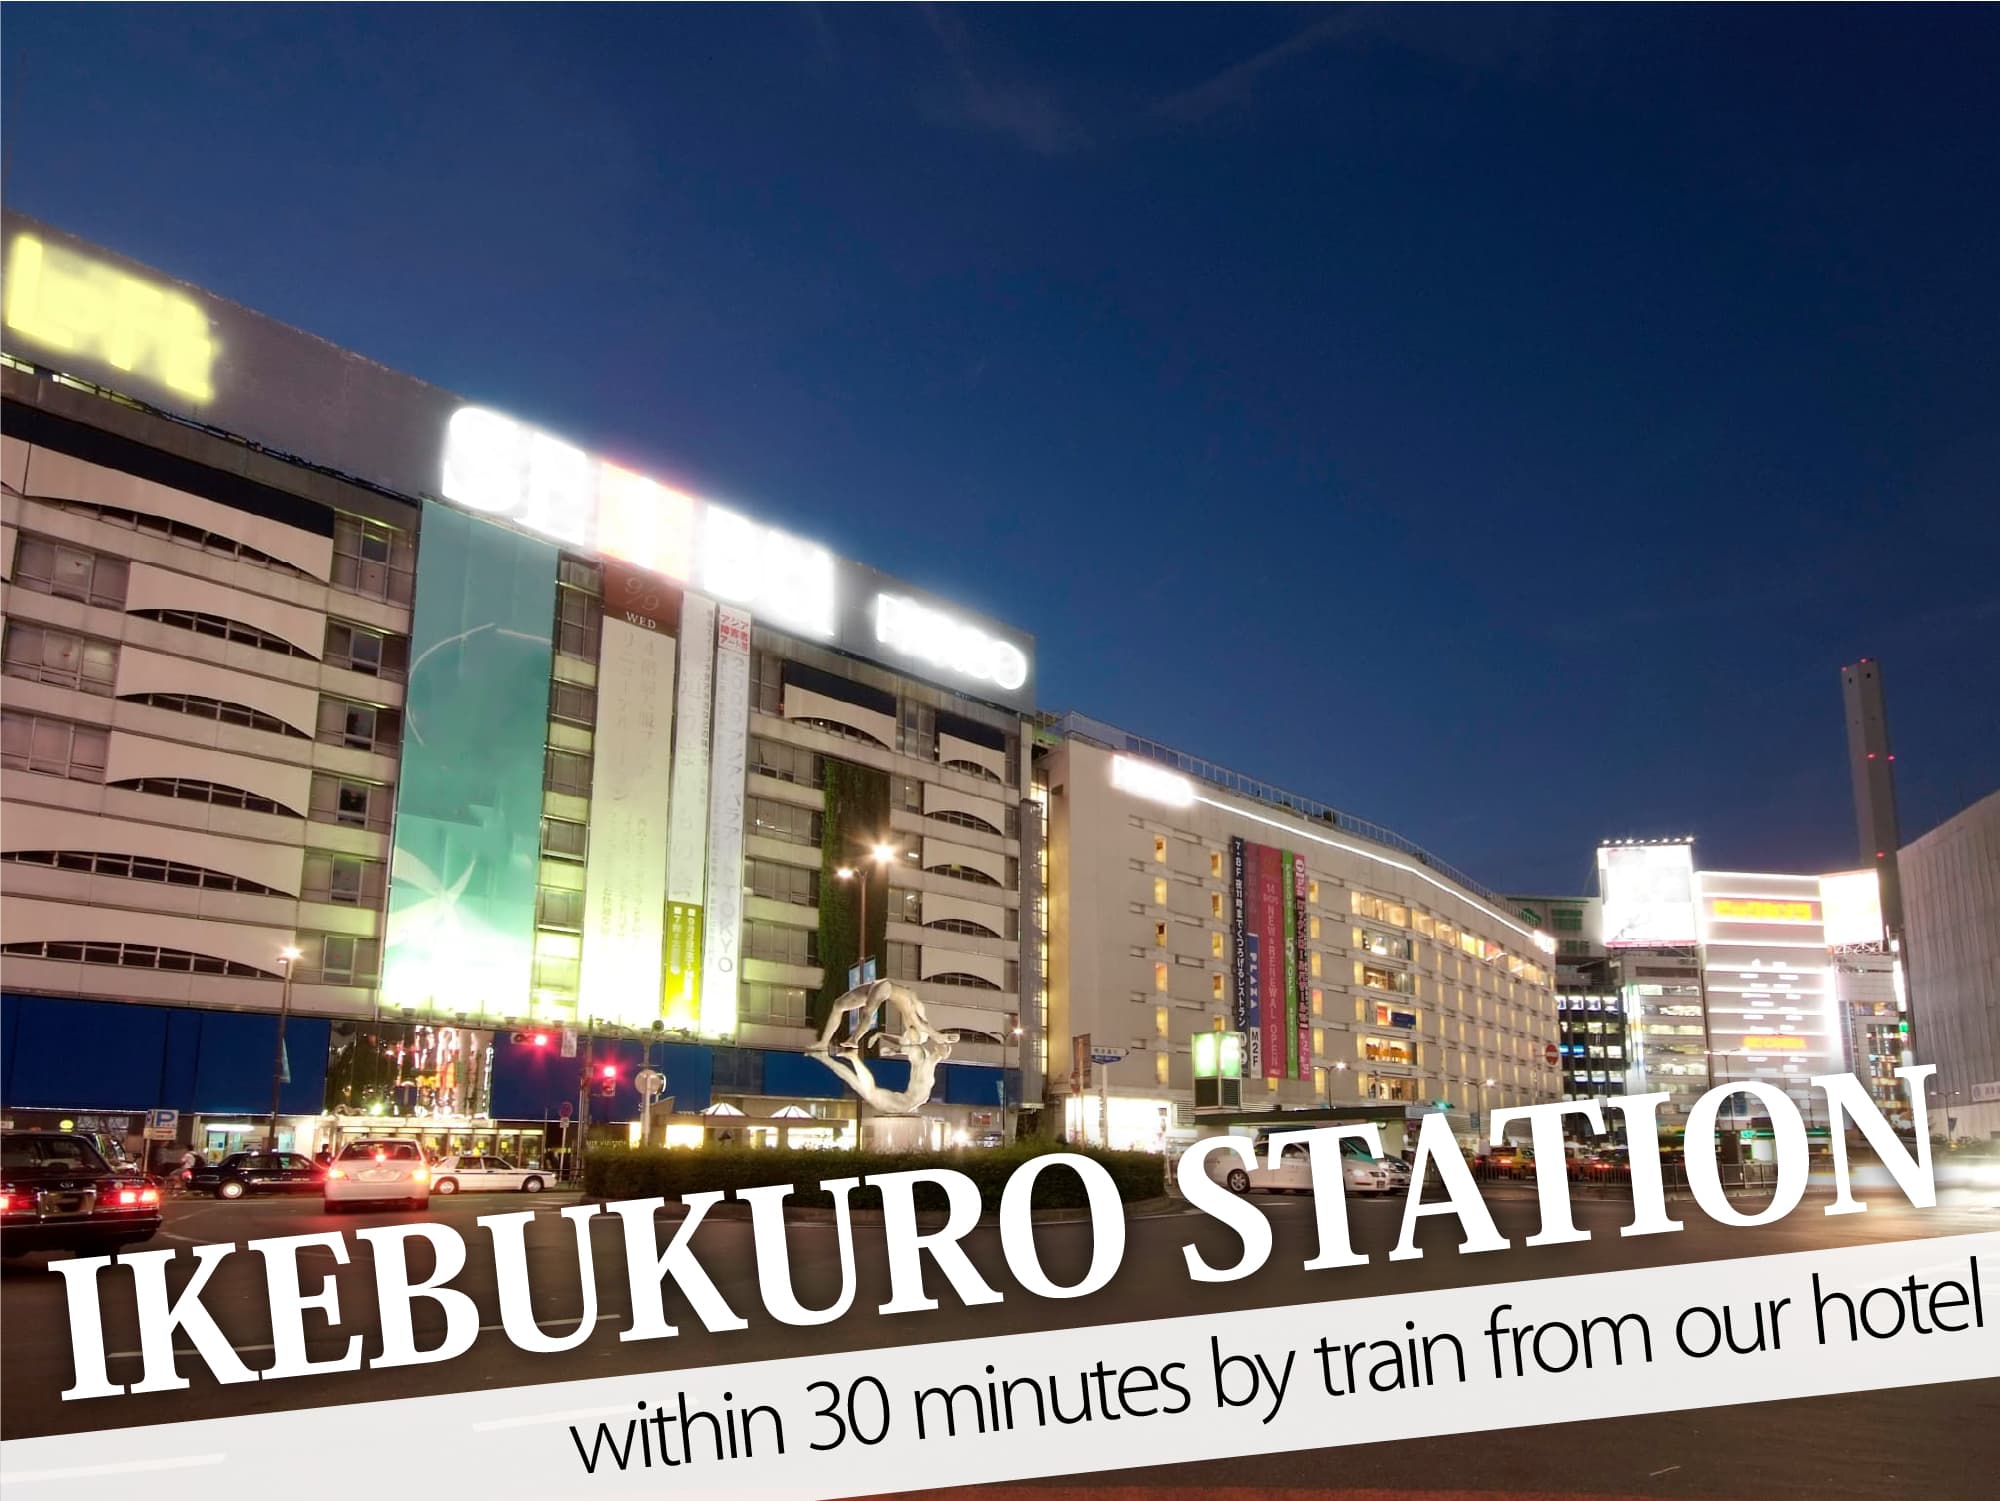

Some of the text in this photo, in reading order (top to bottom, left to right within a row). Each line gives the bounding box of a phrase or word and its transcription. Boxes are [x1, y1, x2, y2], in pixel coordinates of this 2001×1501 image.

[626, 611, 656, 629] WED
[720, 614, 749, 629] アジア
[1251, 1031, 1260, 1068] M2F
